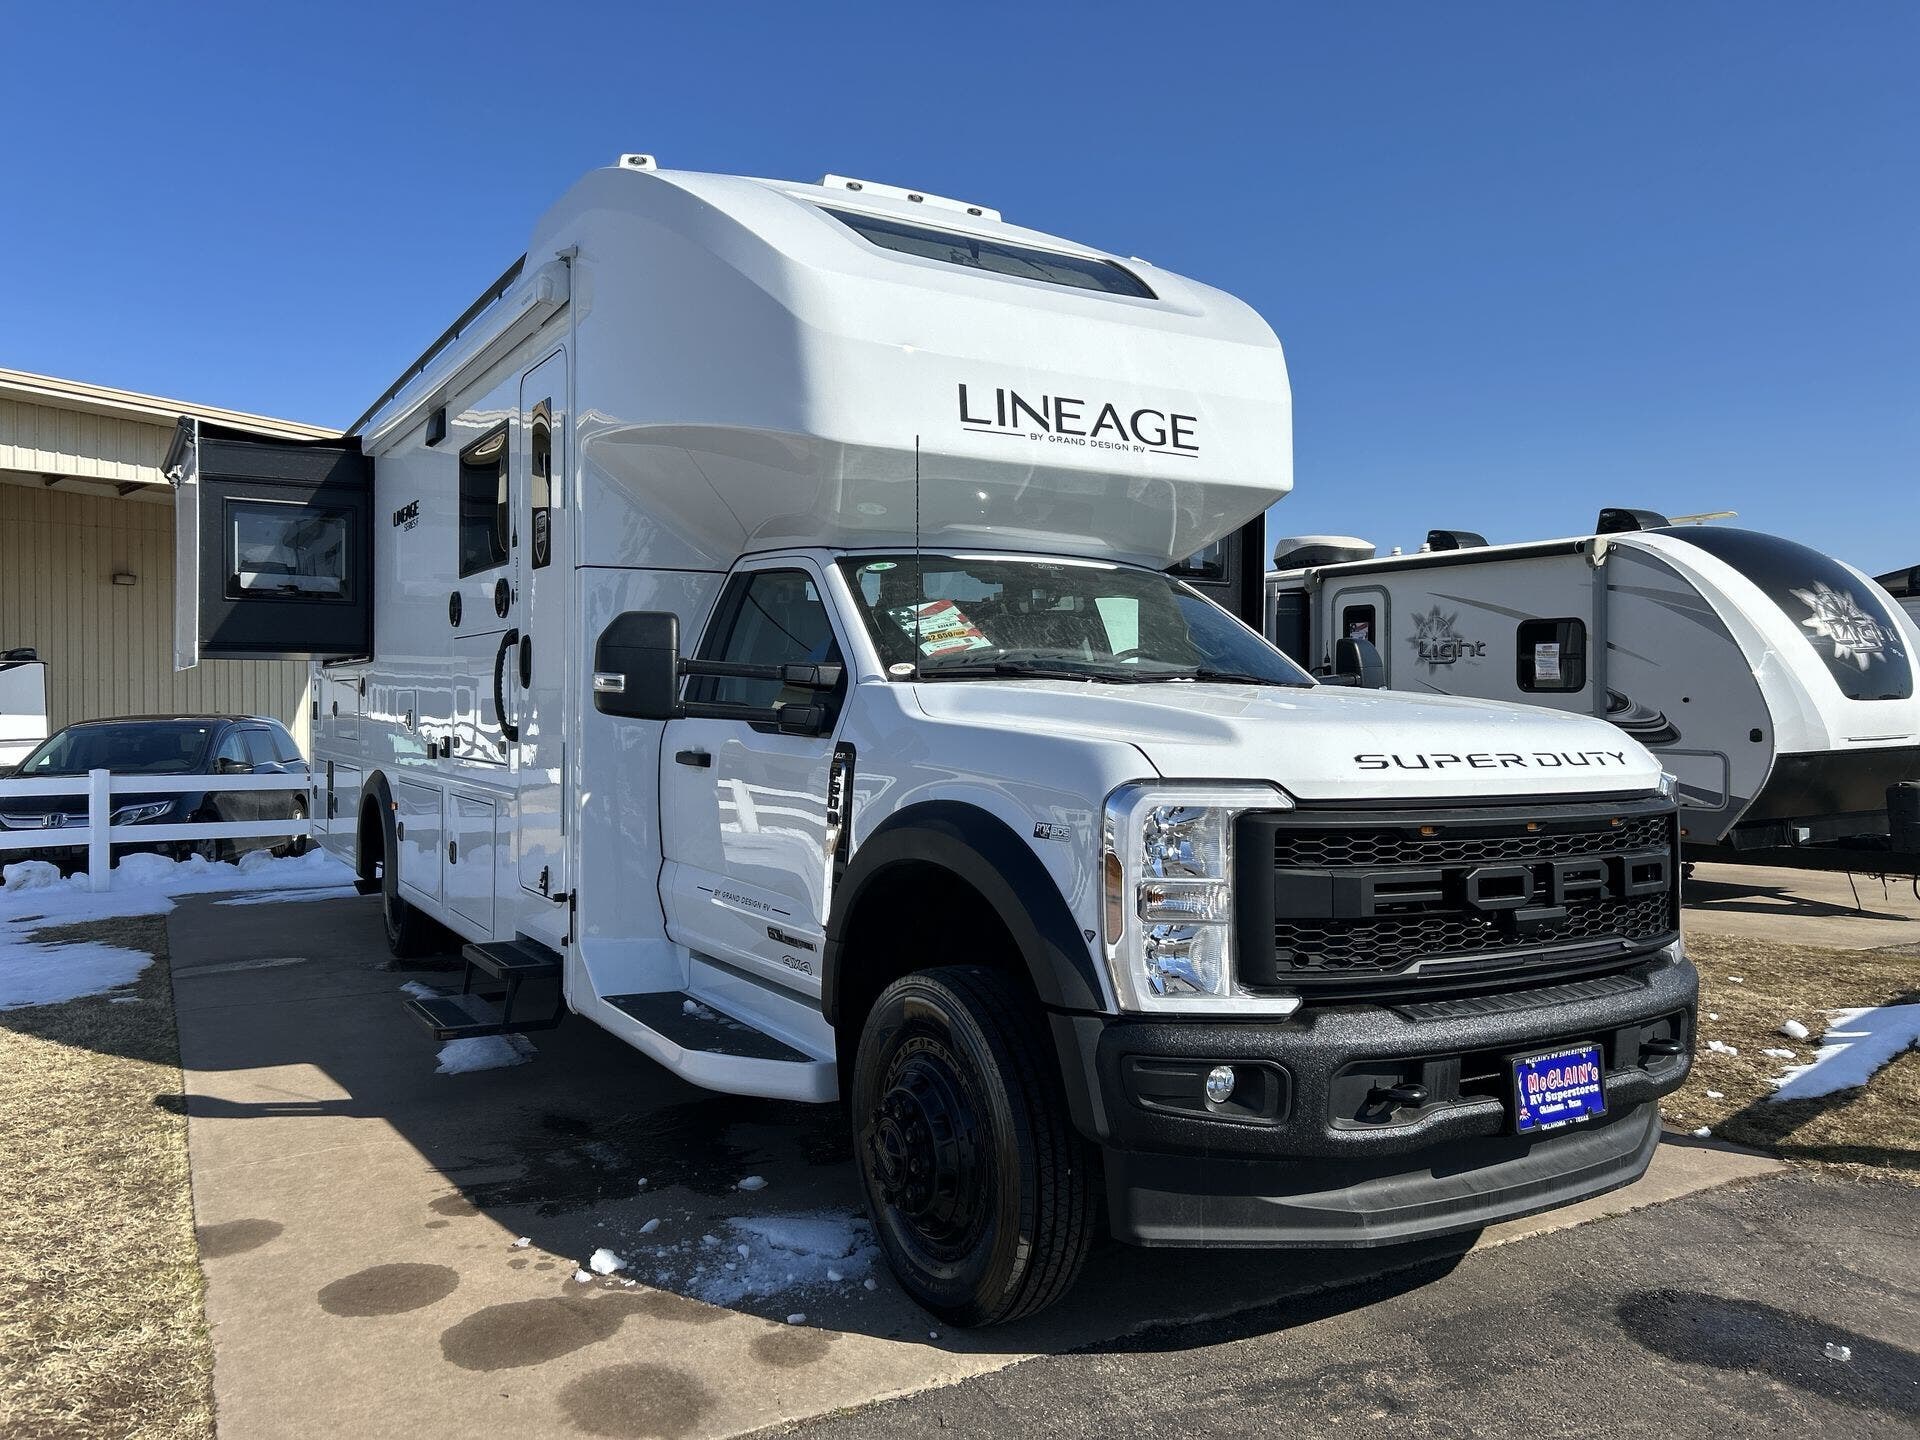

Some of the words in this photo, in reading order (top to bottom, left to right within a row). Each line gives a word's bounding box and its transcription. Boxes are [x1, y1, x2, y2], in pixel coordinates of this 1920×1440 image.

[958, 383, 1199, 451] LINEAGE
[1030, 433, 1043, 442] BY
[1048, 435, 1086, 446] GRAND
[1090, 440, 1129, 451] DESIGN
[1133, 445, 1145, 453] RV
[393, 500, 420, 527] LINEAGE
[1353, 753, 1528, 770] SUPER
[1532, 751, 1627, 767] DUTY
[1361, 849, 1670, 918] FORD
[722, 891, 741, 902] GRAND
[741, 896, 762, 909] DESIGN
[763, 903, 771, 911] RV
[1529, 1094, 1543, 1105] RV
[1544, 1084, 1599, 1102] Superstores
